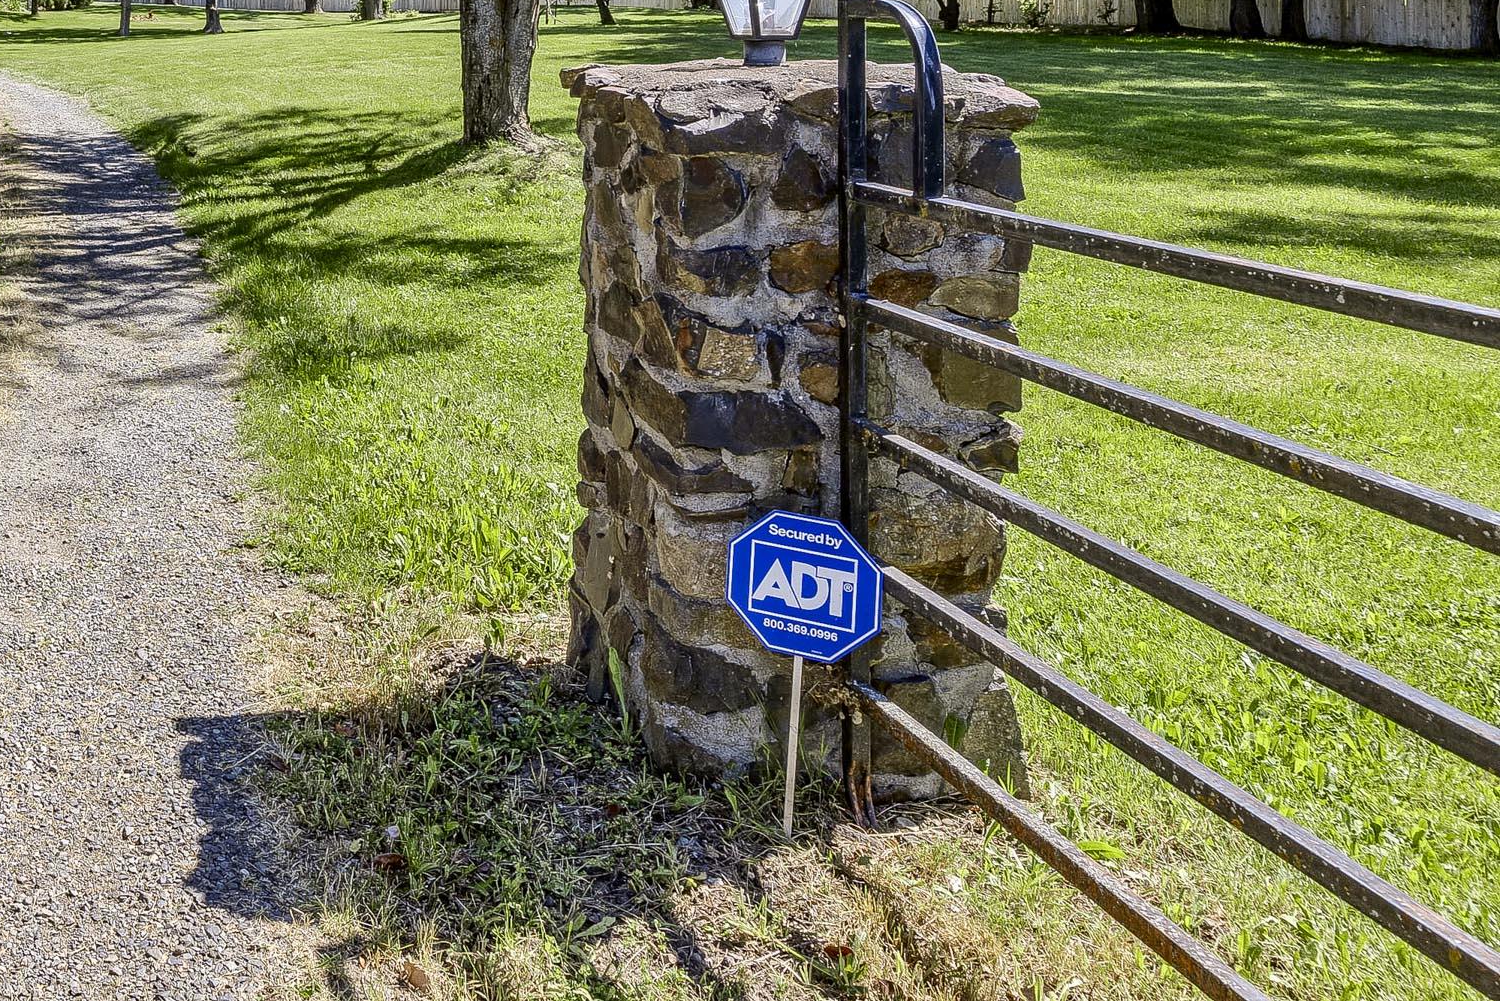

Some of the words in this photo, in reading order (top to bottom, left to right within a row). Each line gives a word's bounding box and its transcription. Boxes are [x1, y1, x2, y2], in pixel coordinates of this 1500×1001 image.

[768, 523, 824, 545] Secured
[825, 534, 842, 549] by
[752, 558, 855, 618] ADT
[763, 618, 838, 642] 800.369.0996
